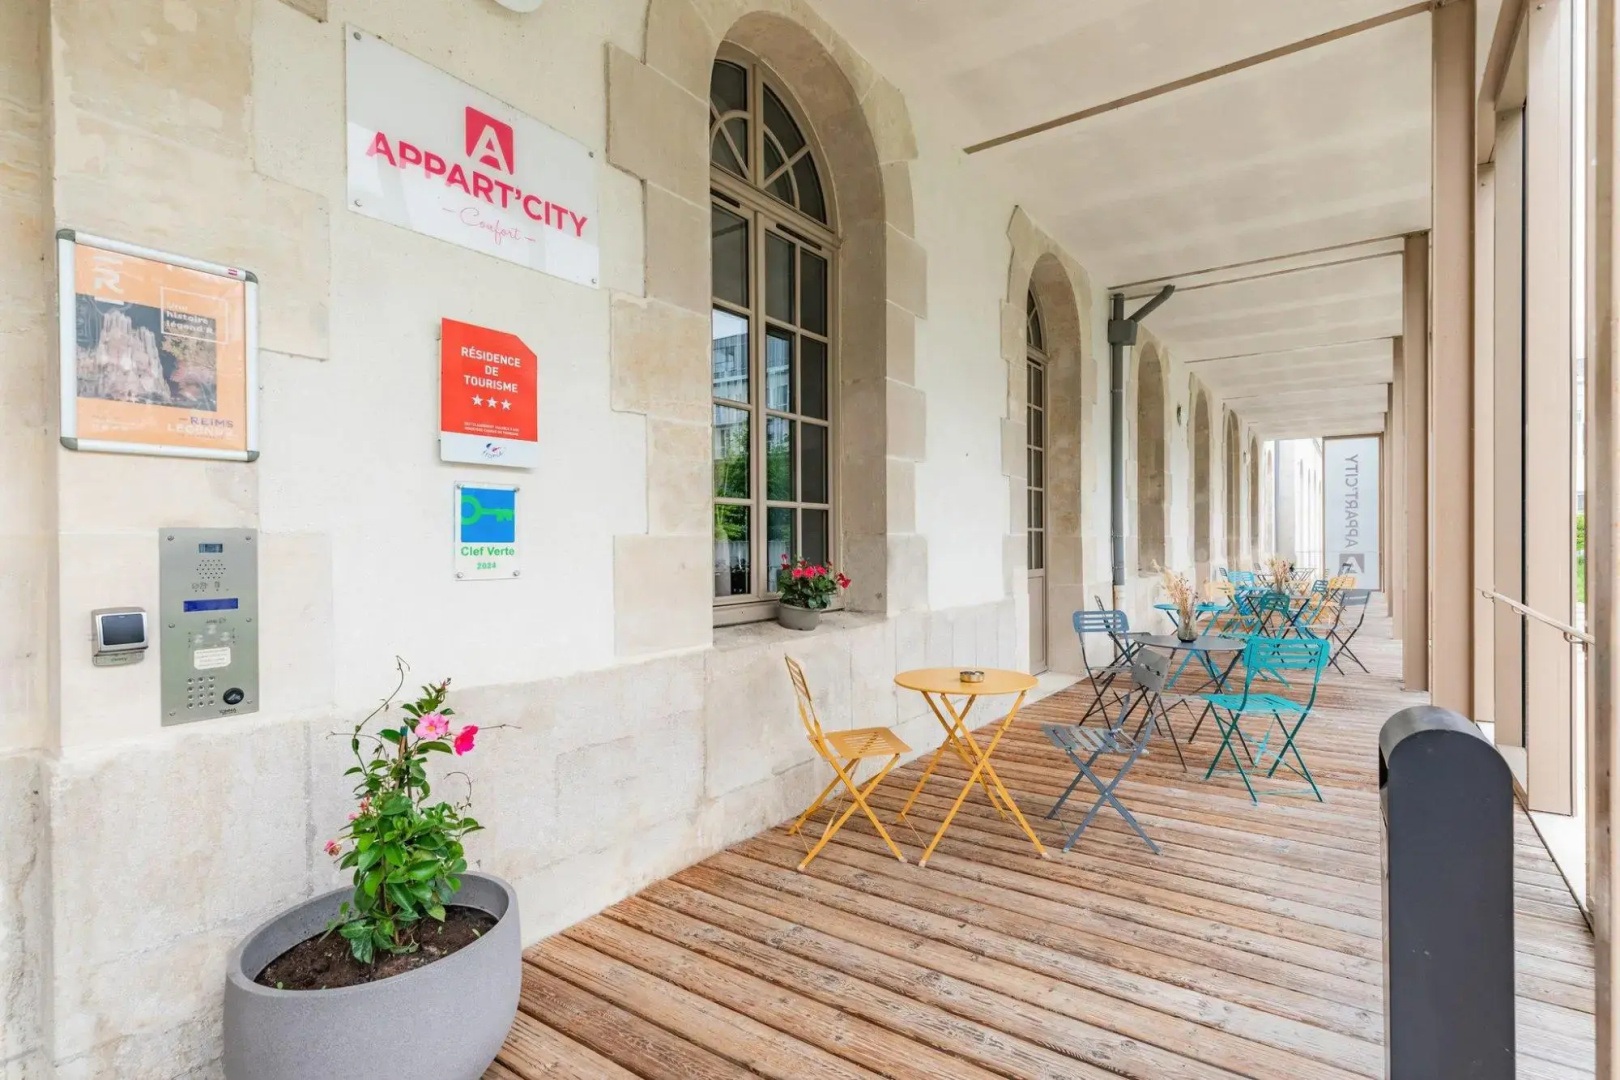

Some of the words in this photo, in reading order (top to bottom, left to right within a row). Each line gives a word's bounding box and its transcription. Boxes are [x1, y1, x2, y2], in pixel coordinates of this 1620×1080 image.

[365, 131, 588, 237] APPART'CITY
[166, 310, 209, 325] histoire
[461, 346, 521, 368] RÉSIDENCE
[484, 365, 499, 377] DE
[464, 375, 518, 393] TOURISME
[190, 416, 234, 428] REIMS
[460, 546, 485, 556] Clef
[487, 546, 516, 556] Verte
